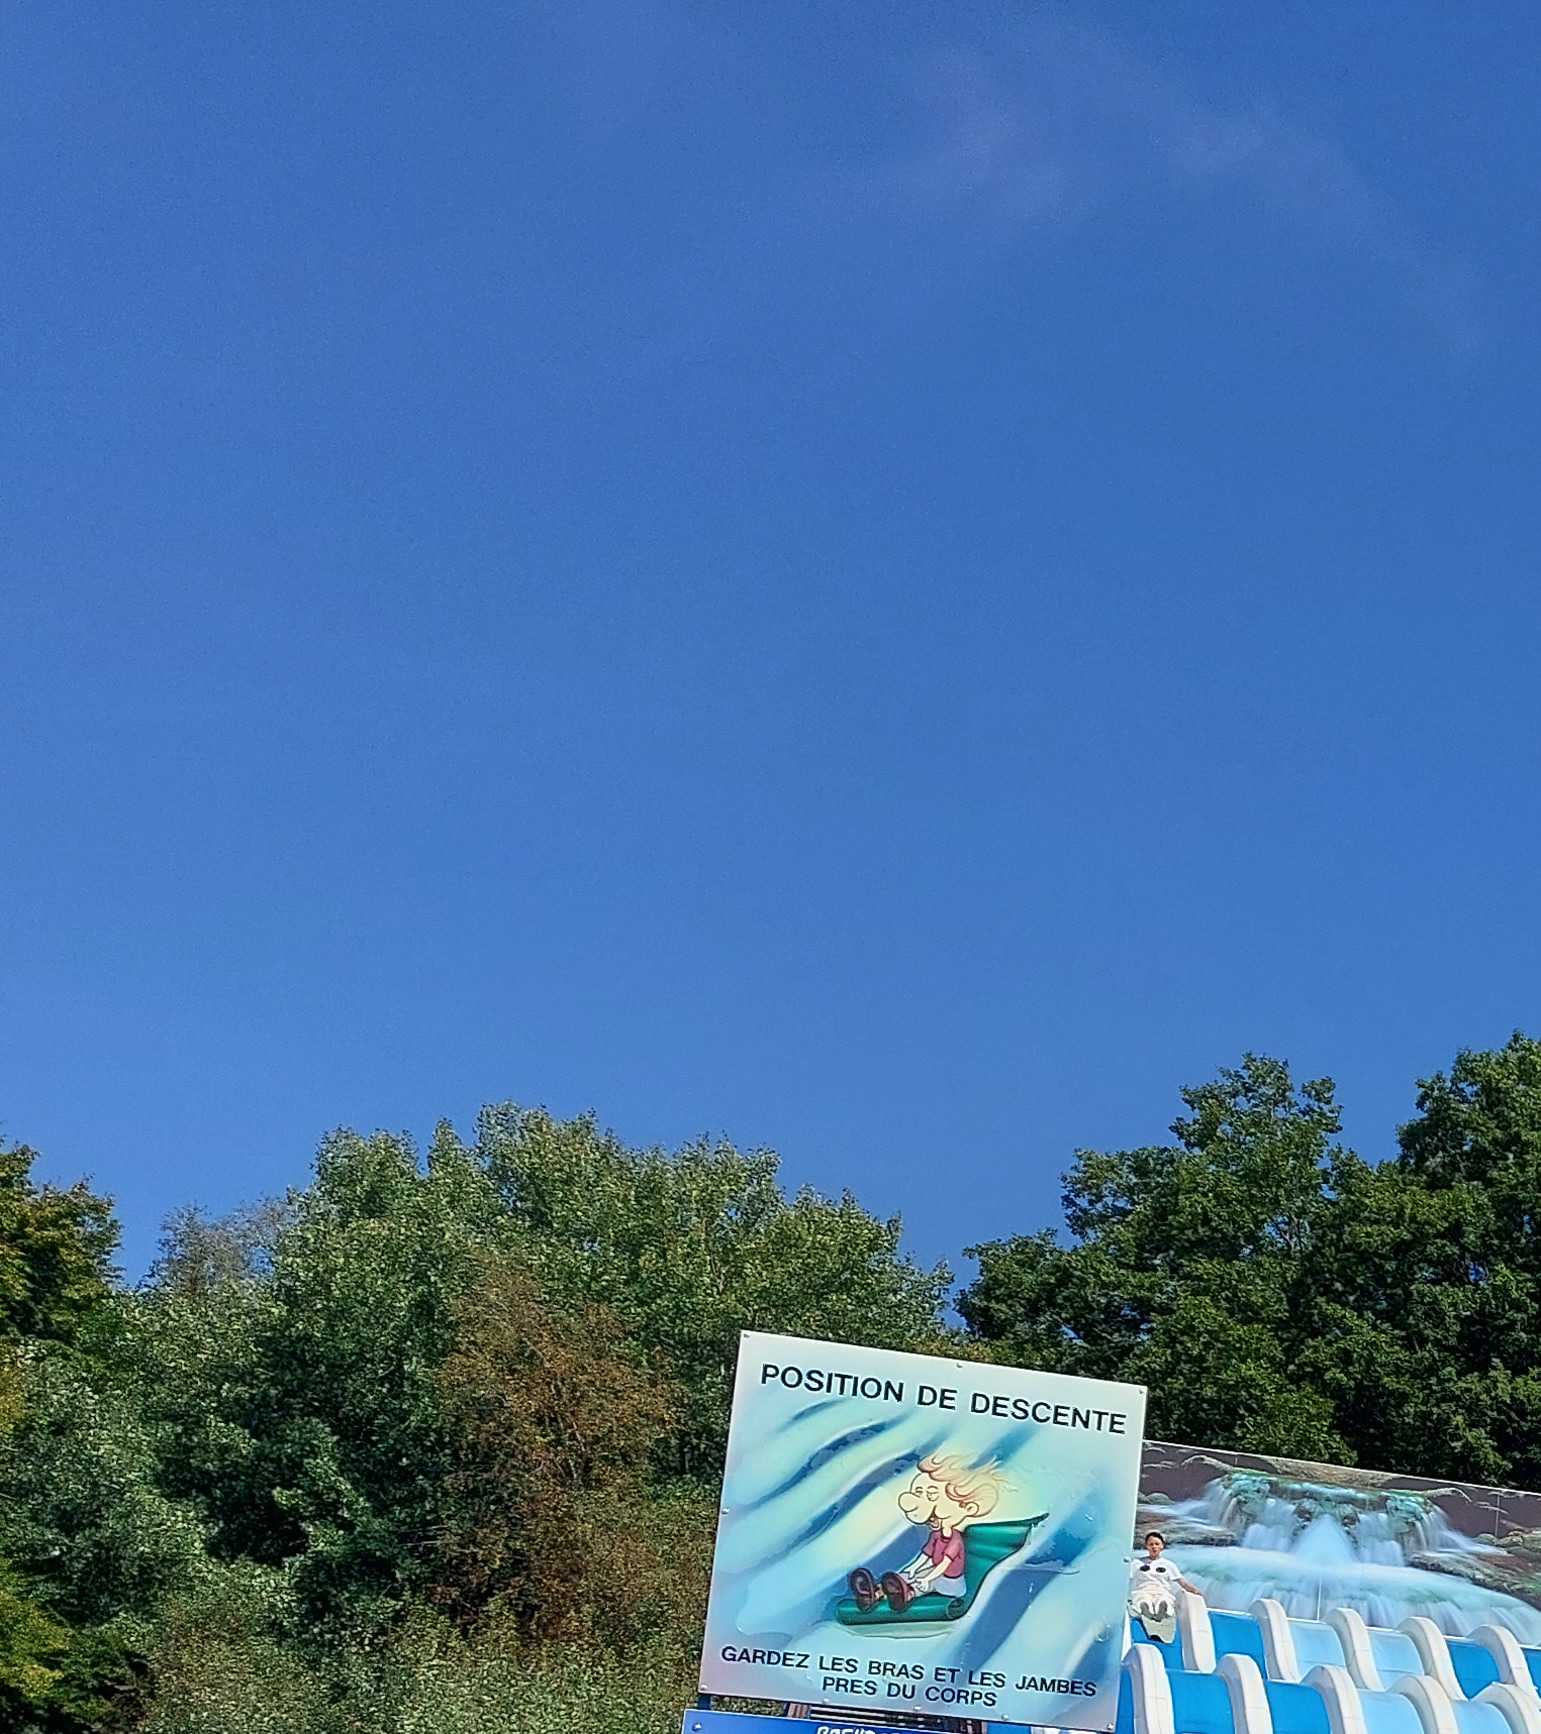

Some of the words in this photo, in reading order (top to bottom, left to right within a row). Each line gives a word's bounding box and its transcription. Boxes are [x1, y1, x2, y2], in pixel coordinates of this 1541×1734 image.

[761, 1363, 904, 1402] POSITION
[917, 1385, 957, 1410] DE
[970, 1392, 1127, 1434] DESCENTE
[721, 1645, 810, 1668] GARDEZ
[818, 1655, 858, 1673] LES
[867, 1660, 924, 1680] BRAS
[934, 1667, 960, 1683] ET
[968, 1670, 1006, 1688] LES
[1015, 1675, 1097, 1697] JAMBES
[821, 1676, 878, 1696] PRES
[886, 1682, 916, 1699] DU
[925, 1686, 998, 1707] CORPS
